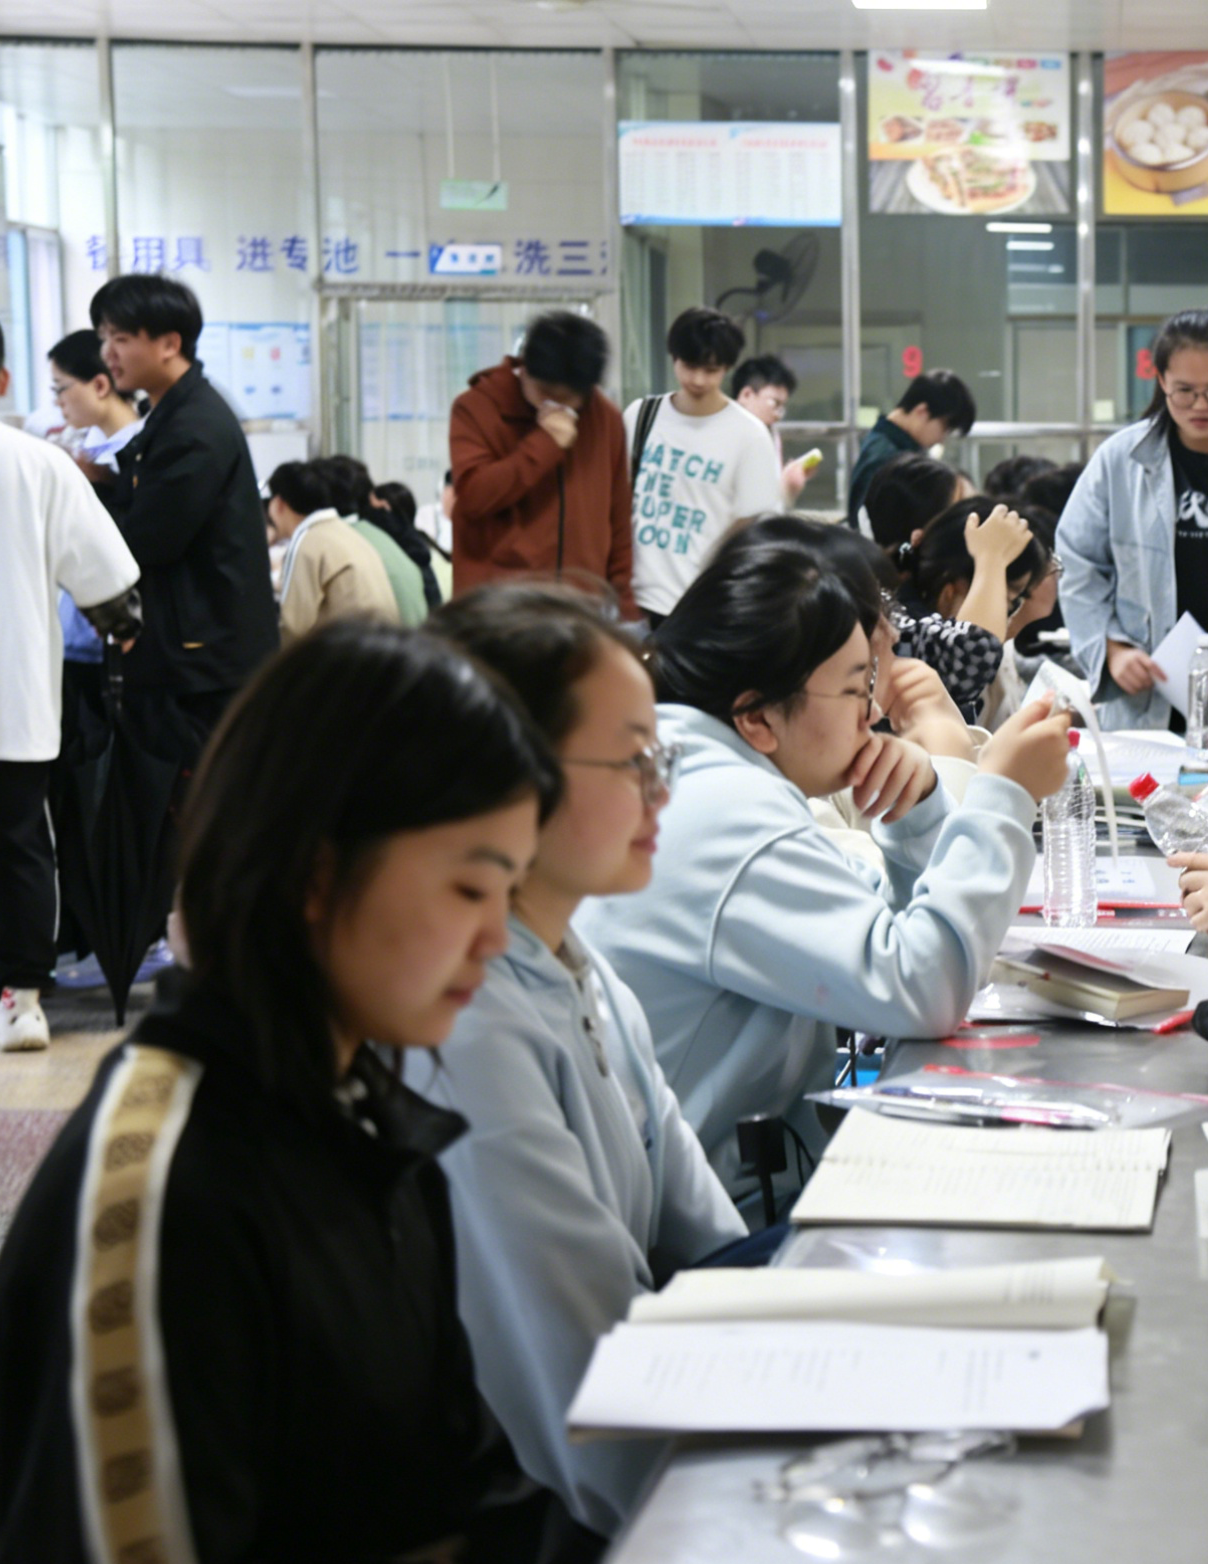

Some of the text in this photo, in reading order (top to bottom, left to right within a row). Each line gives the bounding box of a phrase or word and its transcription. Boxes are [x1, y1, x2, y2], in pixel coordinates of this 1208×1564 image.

[902, 345, 923, 378] 9
[634, 492, 707, 534] UPER
[635, 523, 691, 555] OON
